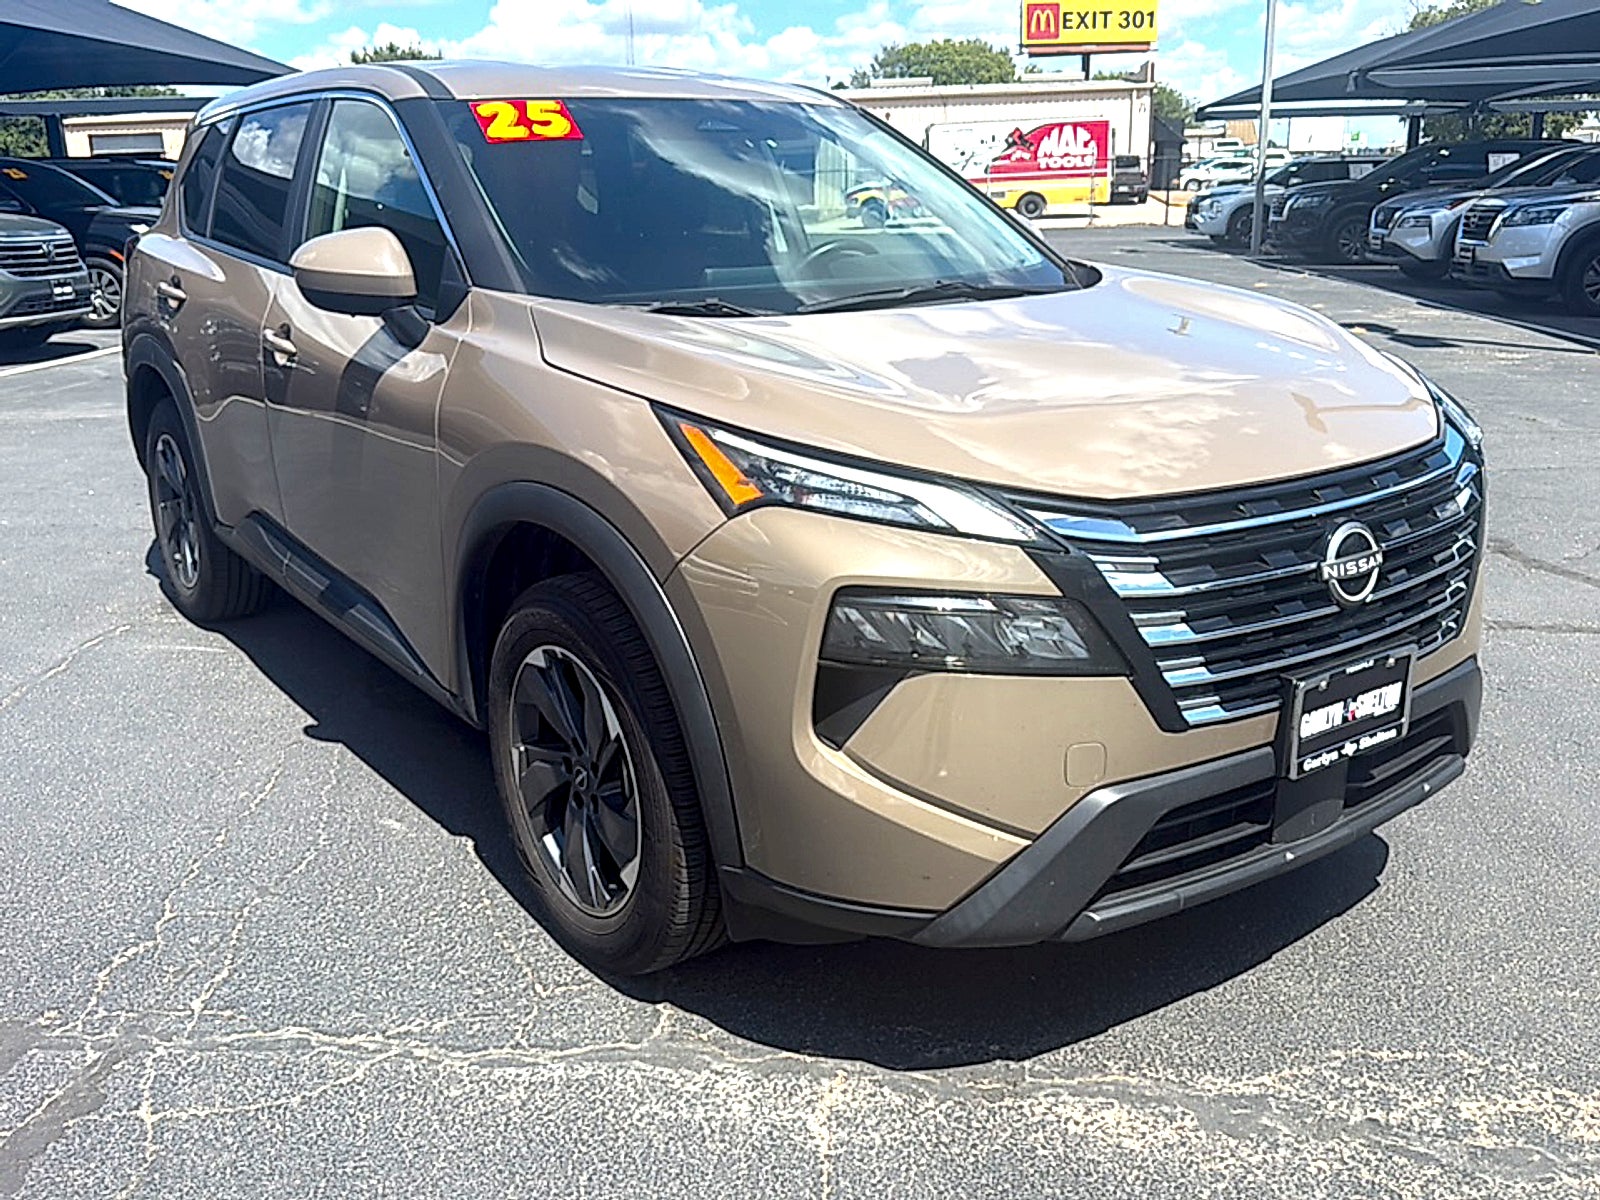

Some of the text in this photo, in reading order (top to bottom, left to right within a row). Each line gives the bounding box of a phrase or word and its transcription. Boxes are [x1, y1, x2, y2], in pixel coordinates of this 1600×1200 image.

[1062, 11, 1113, 29] EXIT
[1118, 10, 1155, 29] 301
[475, 101, 571, 138] 25
[1037, 125, 1097, 157] MAC
[1037, 155, 1097, 169] TOOLS
[1323, 553, 1383, 579] NISSAN
